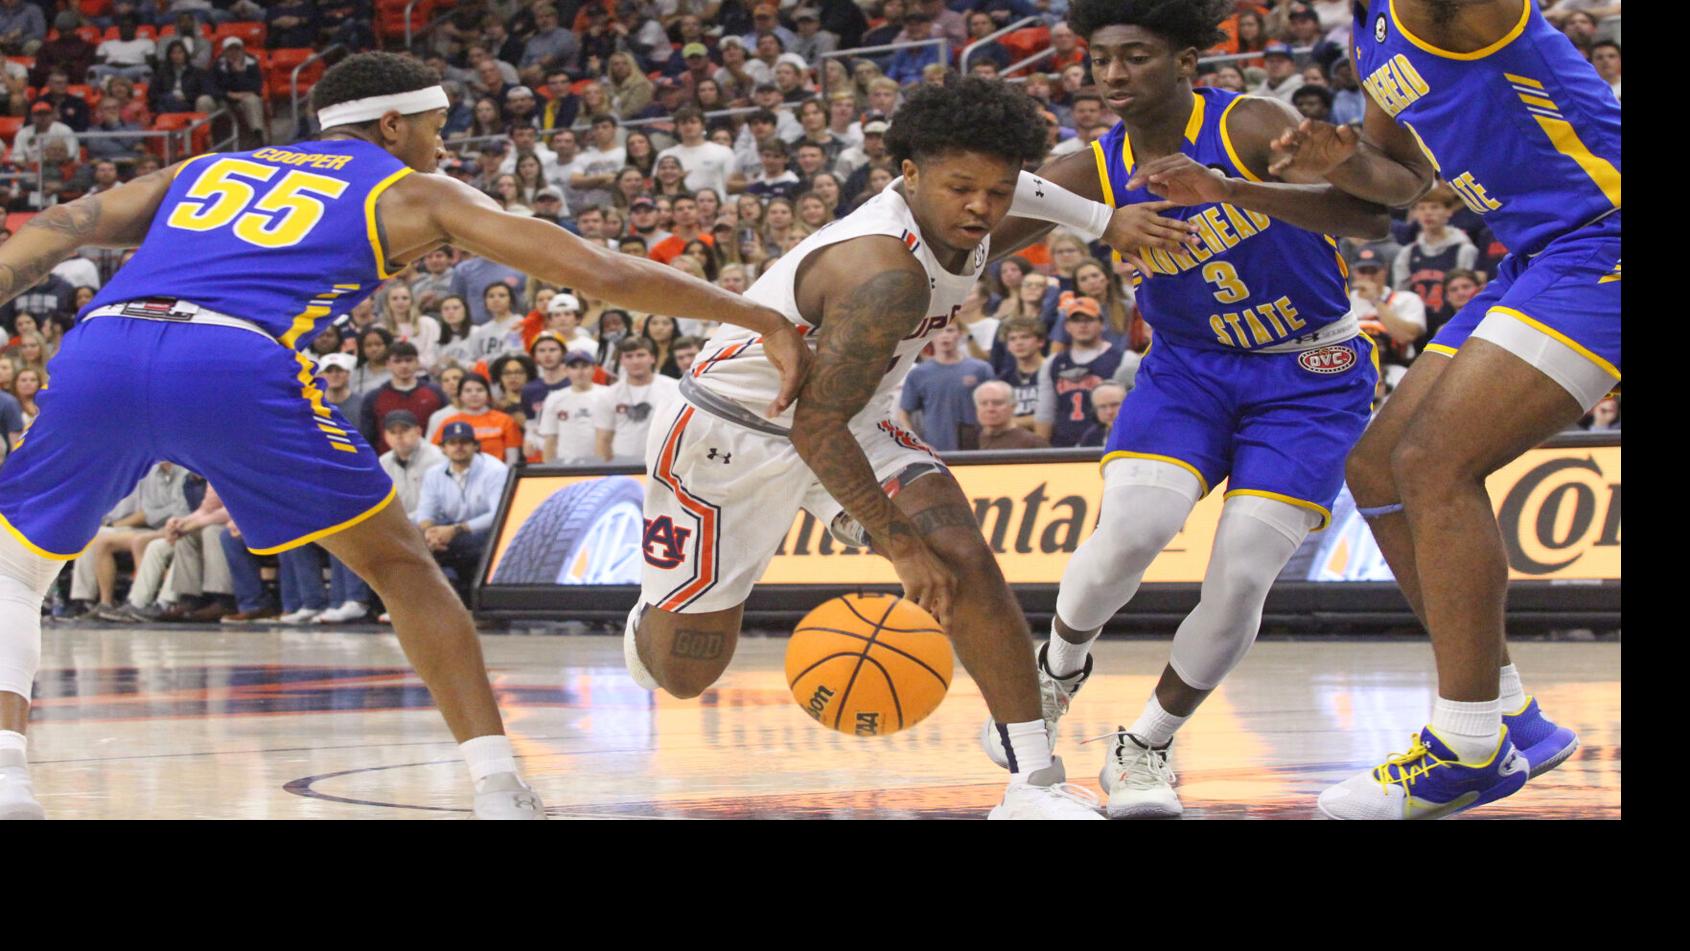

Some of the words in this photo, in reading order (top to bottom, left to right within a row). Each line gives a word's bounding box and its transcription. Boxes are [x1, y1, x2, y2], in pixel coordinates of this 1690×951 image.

[252, 147, 354, 170] COOPER
[167, 157, 350, 248] 55
[1202, 261, 1250, 304] 3
[1209, 295, 1306, 349] STATE
[1309, 351, 1344, 367] OVC
[1070, 392, 1085, 420] 1
[675, 631, 722, 658] GOD
